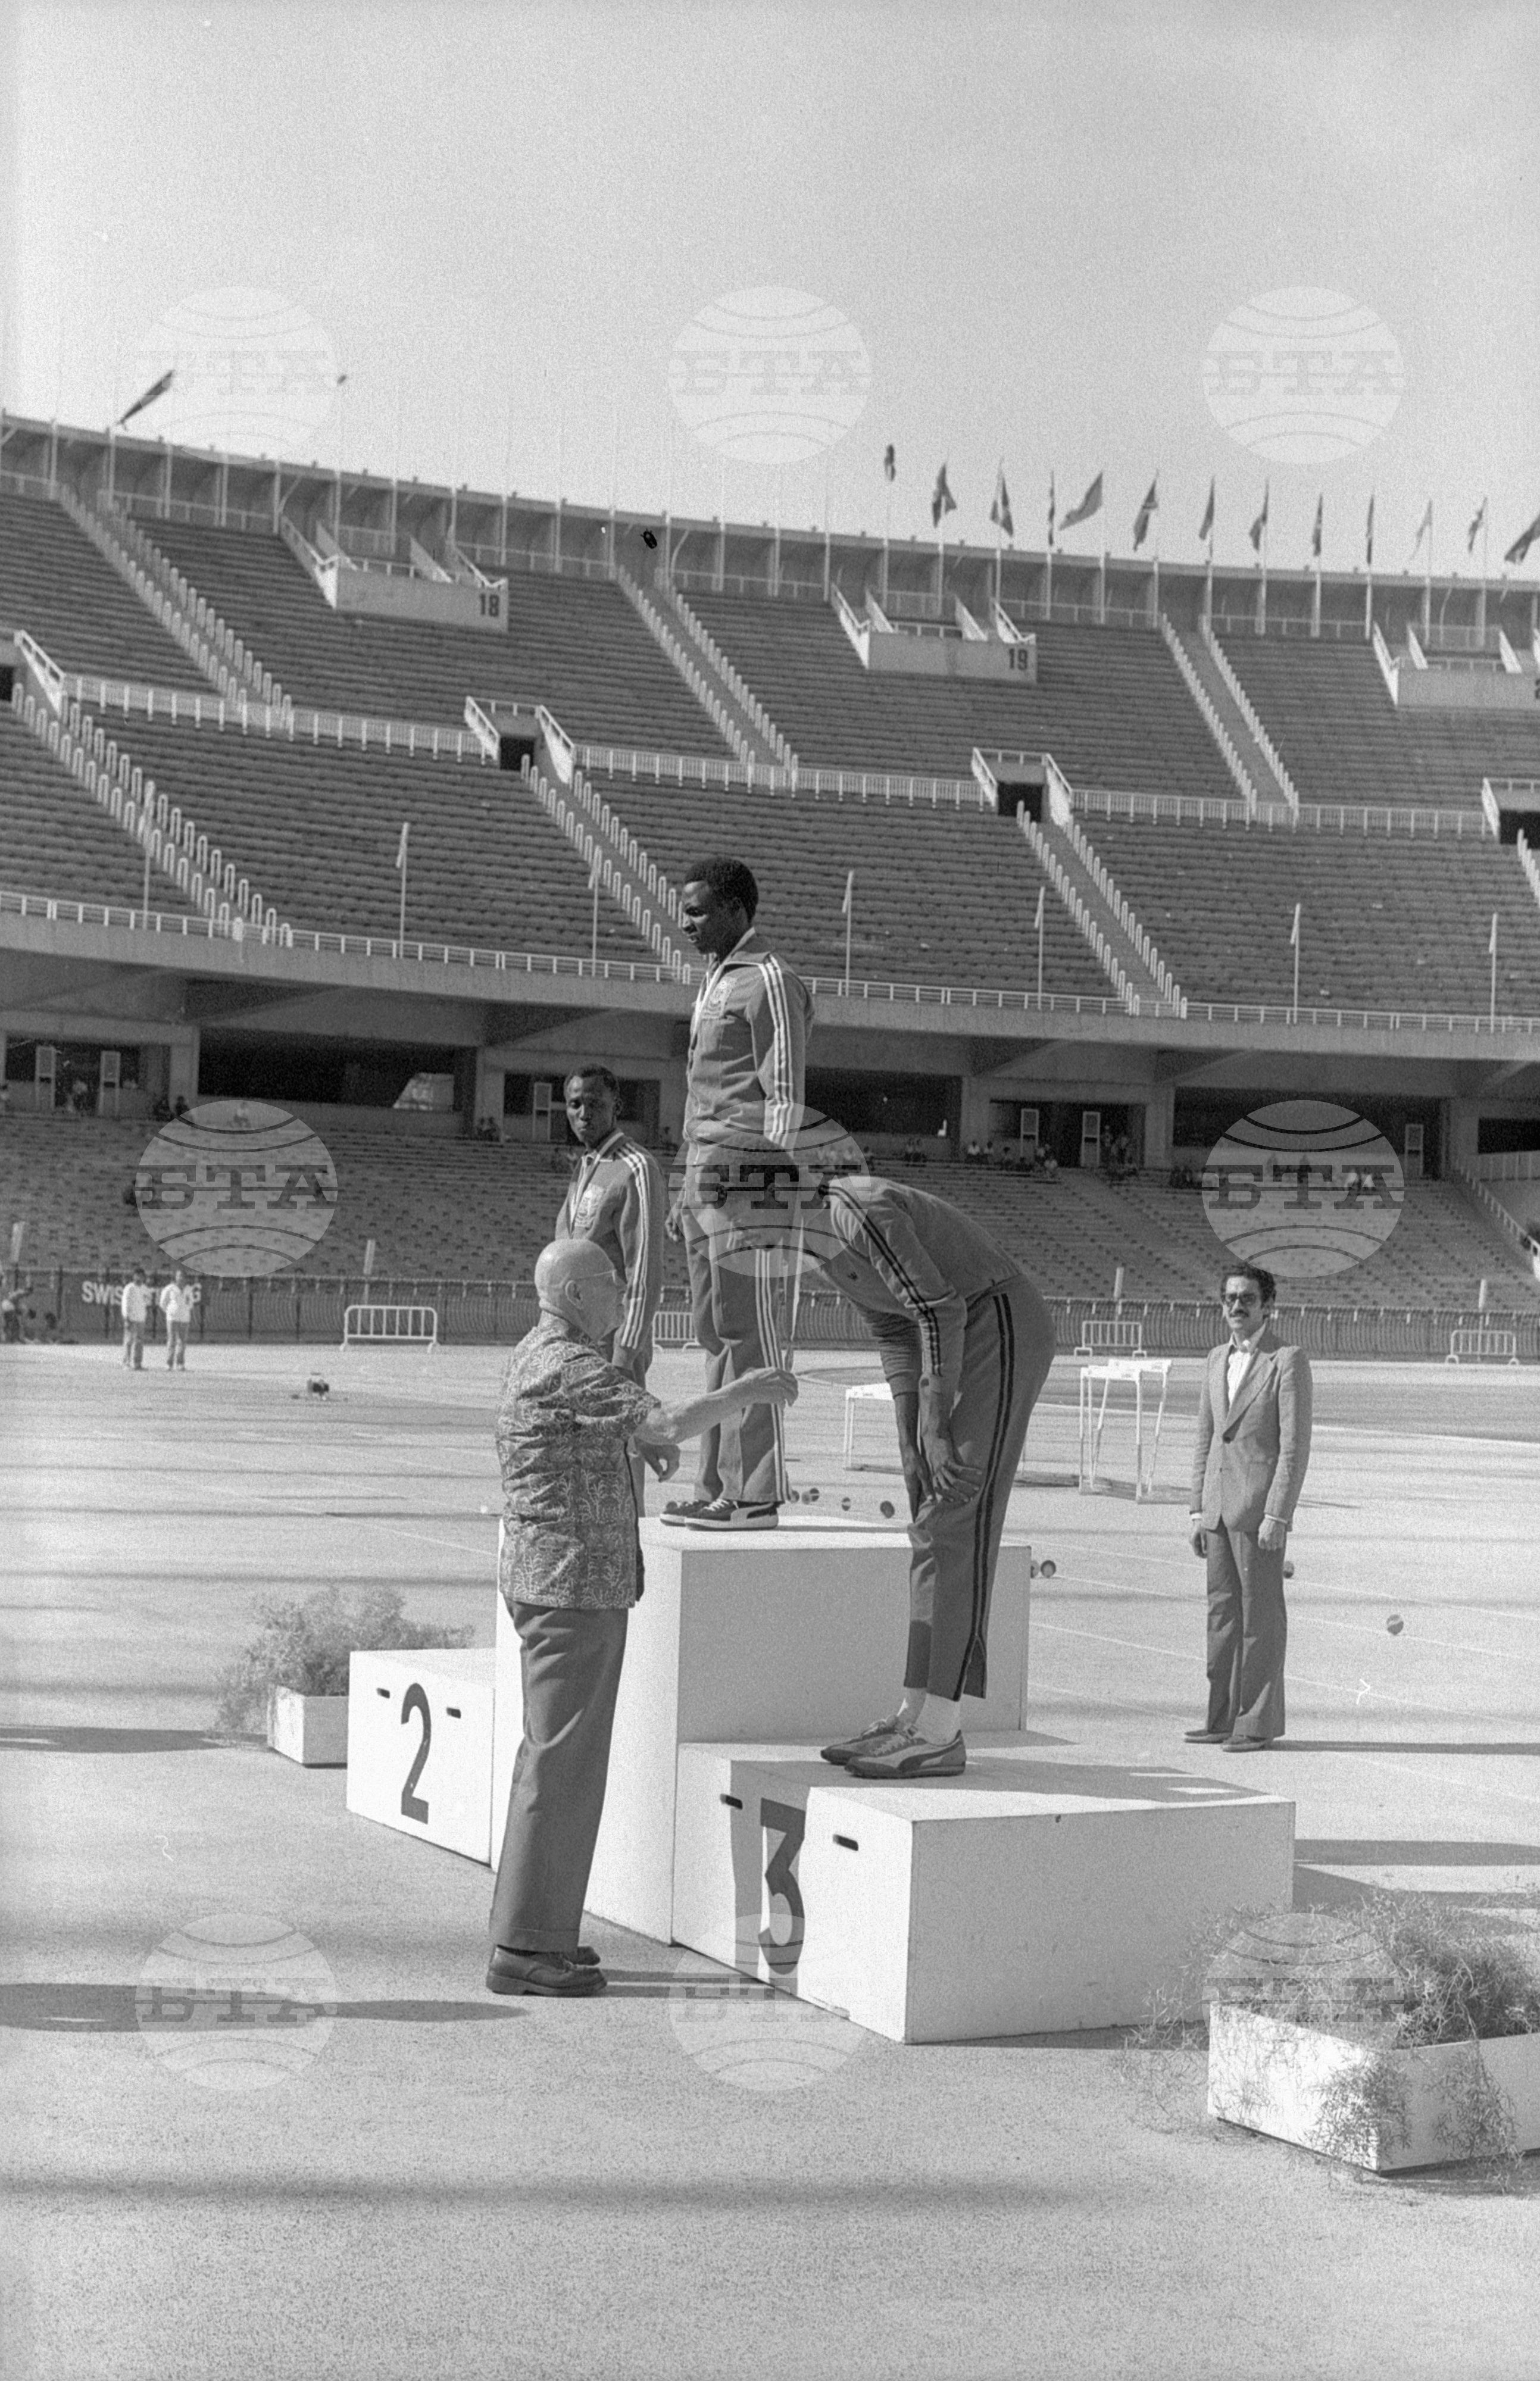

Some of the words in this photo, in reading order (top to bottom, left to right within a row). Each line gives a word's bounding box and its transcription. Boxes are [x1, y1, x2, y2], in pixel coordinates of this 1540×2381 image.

[479, 593, 499, 617] 18
[1009, 648, 1028, 671] 19
[401, 1682, 432, 1825] 2
[758, 1796, 806, 1975] 3
